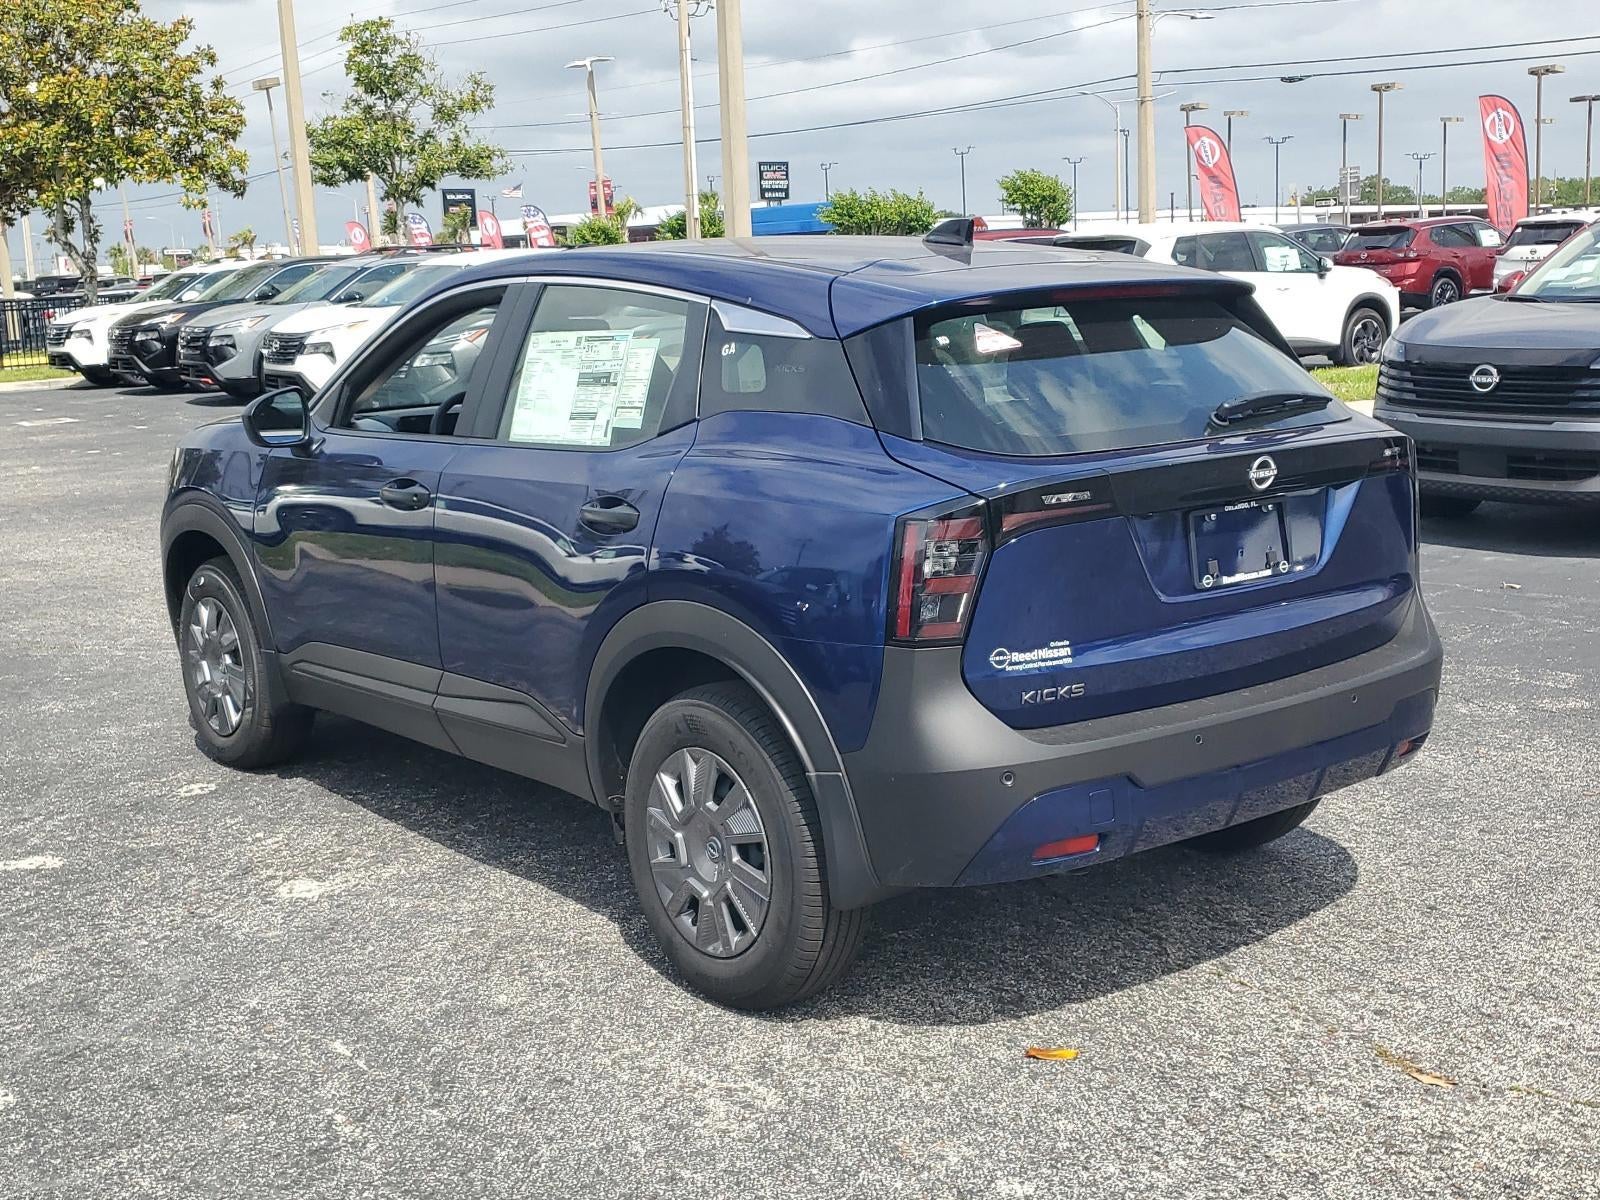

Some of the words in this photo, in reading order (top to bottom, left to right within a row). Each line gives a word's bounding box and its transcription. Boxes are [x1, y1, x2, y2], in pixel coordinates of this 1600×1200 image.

[762, 171, 787, 179] GMC
[721, 342, 736, 356] GA
[1469, 375, 1500, 383] NISSAN
[1249, 467, 1278, 479] NISSAN
[1012, 649, 1038, 662] Reed
[1038, 647, 1071, 660] Nissan
[1021, 682, 1085, 705] KICKS
